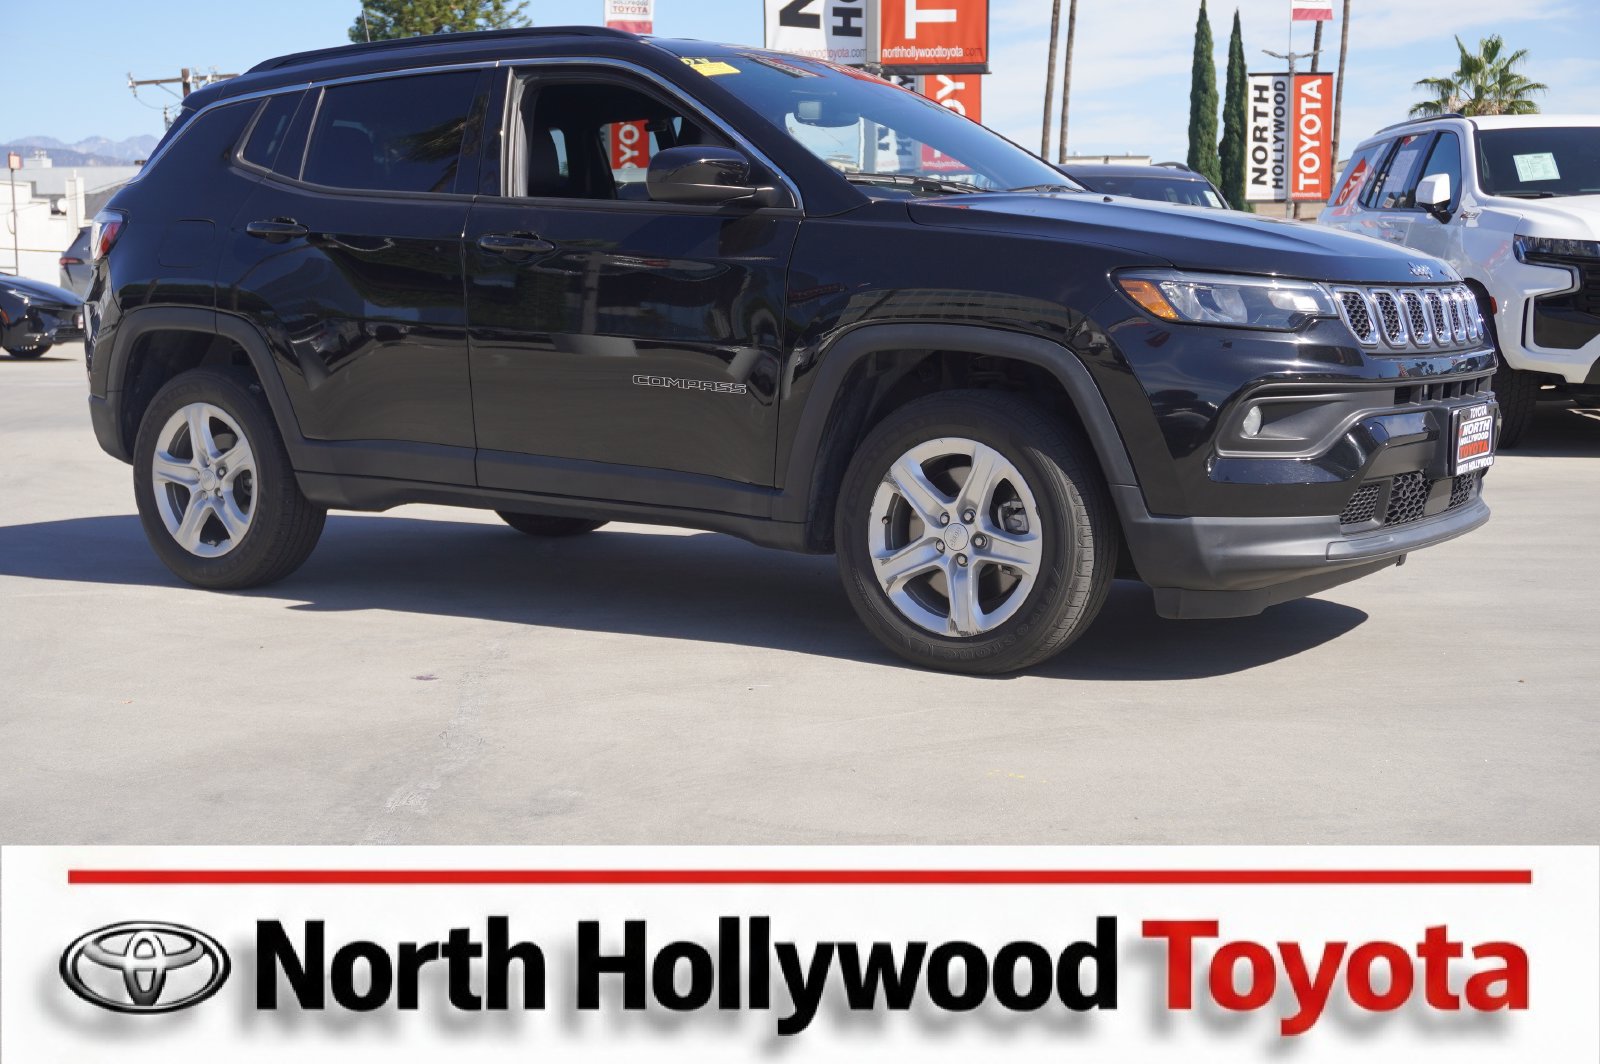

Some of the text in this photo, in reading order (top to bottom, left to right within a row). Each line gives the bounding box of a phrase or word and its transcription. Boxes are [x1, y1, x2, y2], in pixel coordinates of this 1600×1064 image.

[882, 46, 983, 61] northhollywoodtoyota.com
[1252, 84, 1269, 185] NORTH
[1272, 81, 1286, 189] HOLLYWOOD
[1298, 79, 1322, 190] TOYOTA
[632, 374, 747, 395] COMPASS
[1470, 405, 1488, 419] TOYOTA
[1462, 420, 1490, 436] NORTH
[1459, 440, 1489, 458] TOYOTA
